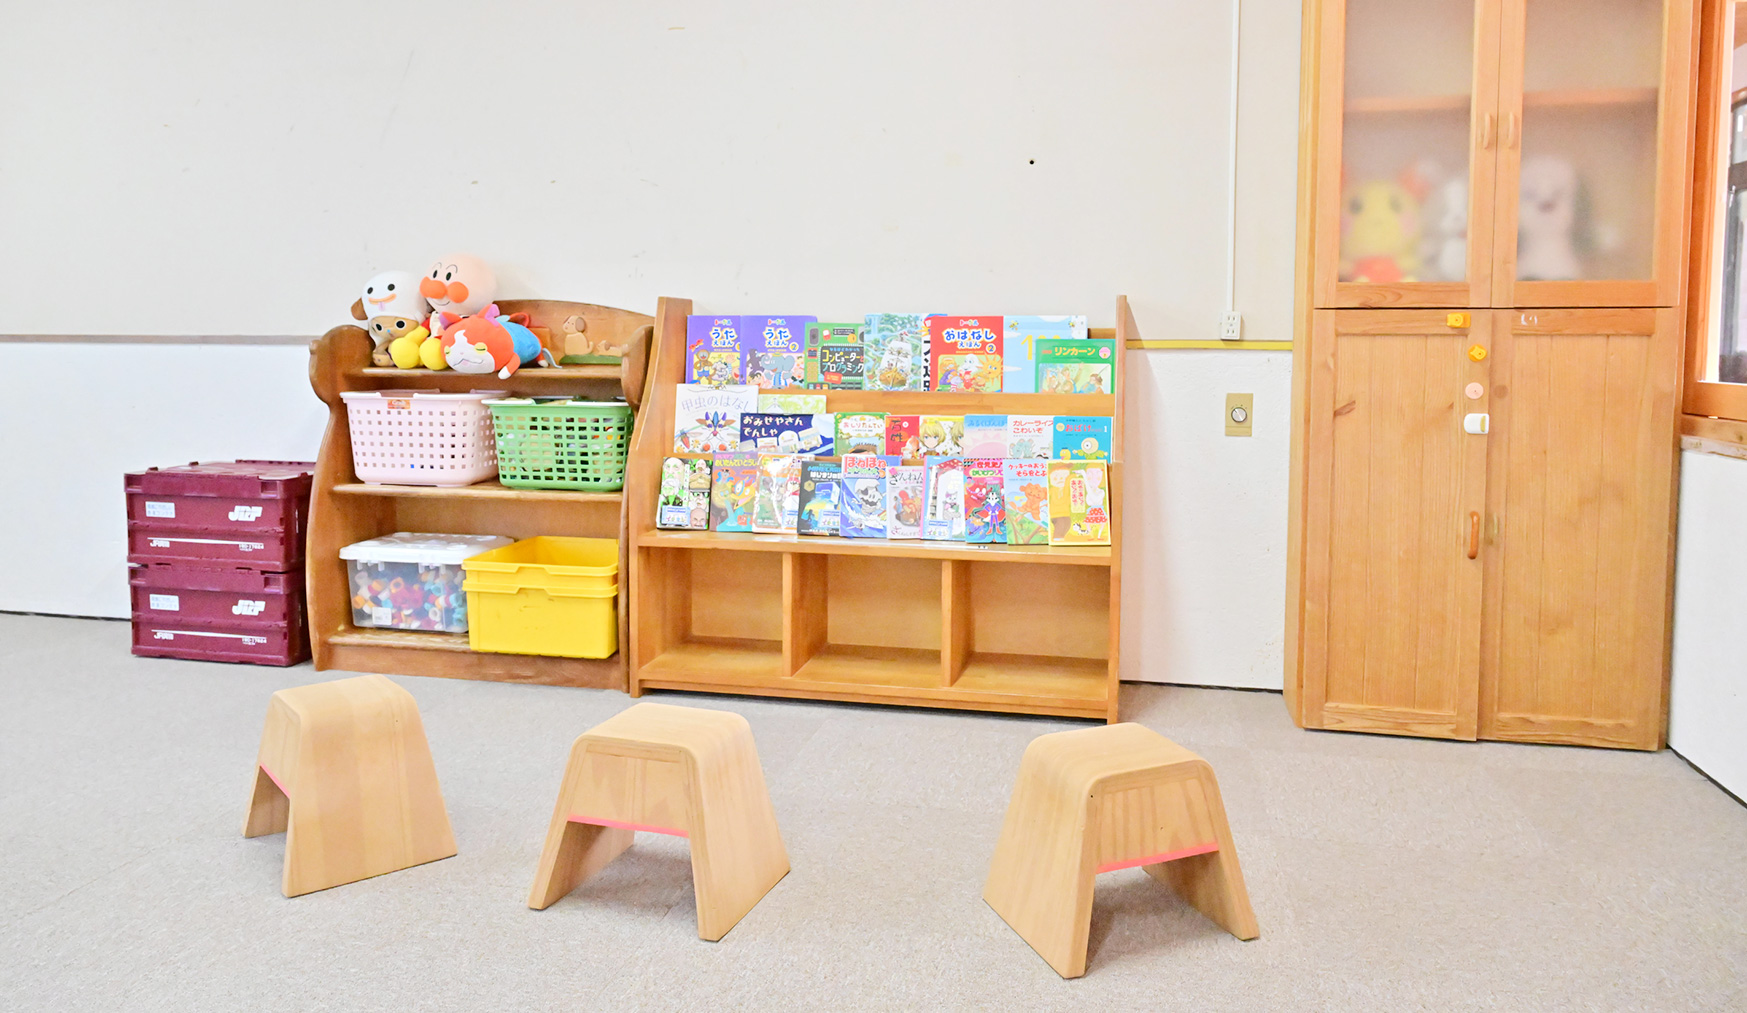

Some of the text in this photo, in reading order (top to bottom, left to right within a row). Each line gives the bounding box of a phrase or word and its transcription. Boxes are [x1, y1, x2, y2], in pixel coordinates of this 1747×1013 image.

[711, 327, 736, 340] うた
[764, 327, 790, 340] うた
[944, 329, 997, 341] おはなし
[712, 340, 735, 348] えほん
[765, 340, 789, 348] えほん
[1054, 346, 1096, 356] リンカーン
[682, 394, 750, 413] 甲虫のはなし
[743, 415, 804, 426] おみせやさん
[743, 427, 778, 437] でんしゃ
[1065, 423, 1092, 433] おばけ
[844, 456, 887, 470] ほねほね
[1008, 462, 1048, 470] クッキーのおう
